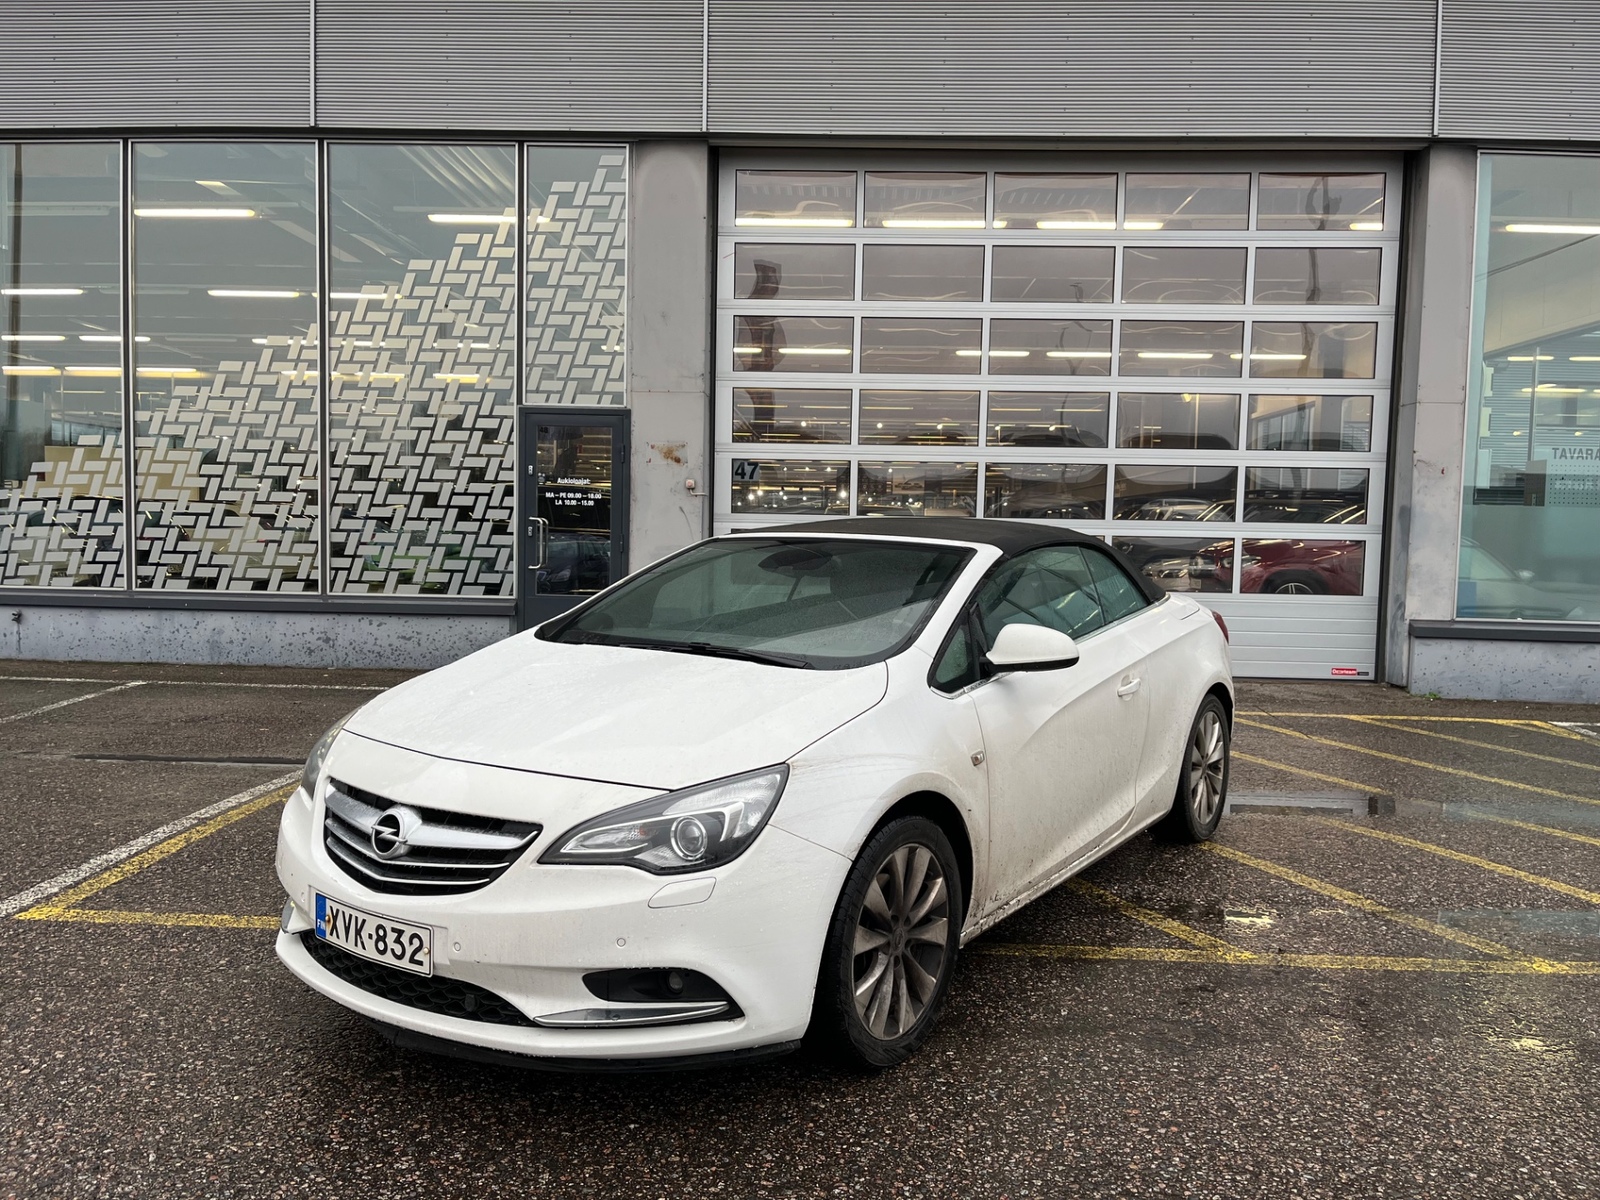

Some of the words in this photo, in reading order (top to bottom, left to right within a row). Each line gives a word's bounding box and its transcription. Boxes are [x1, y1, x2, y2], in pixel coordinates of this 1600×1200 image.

[734, 461, 759, 480] 47
[317, 919, 326, 930] FIN
[329, 905, 424, 967] XVK-832
